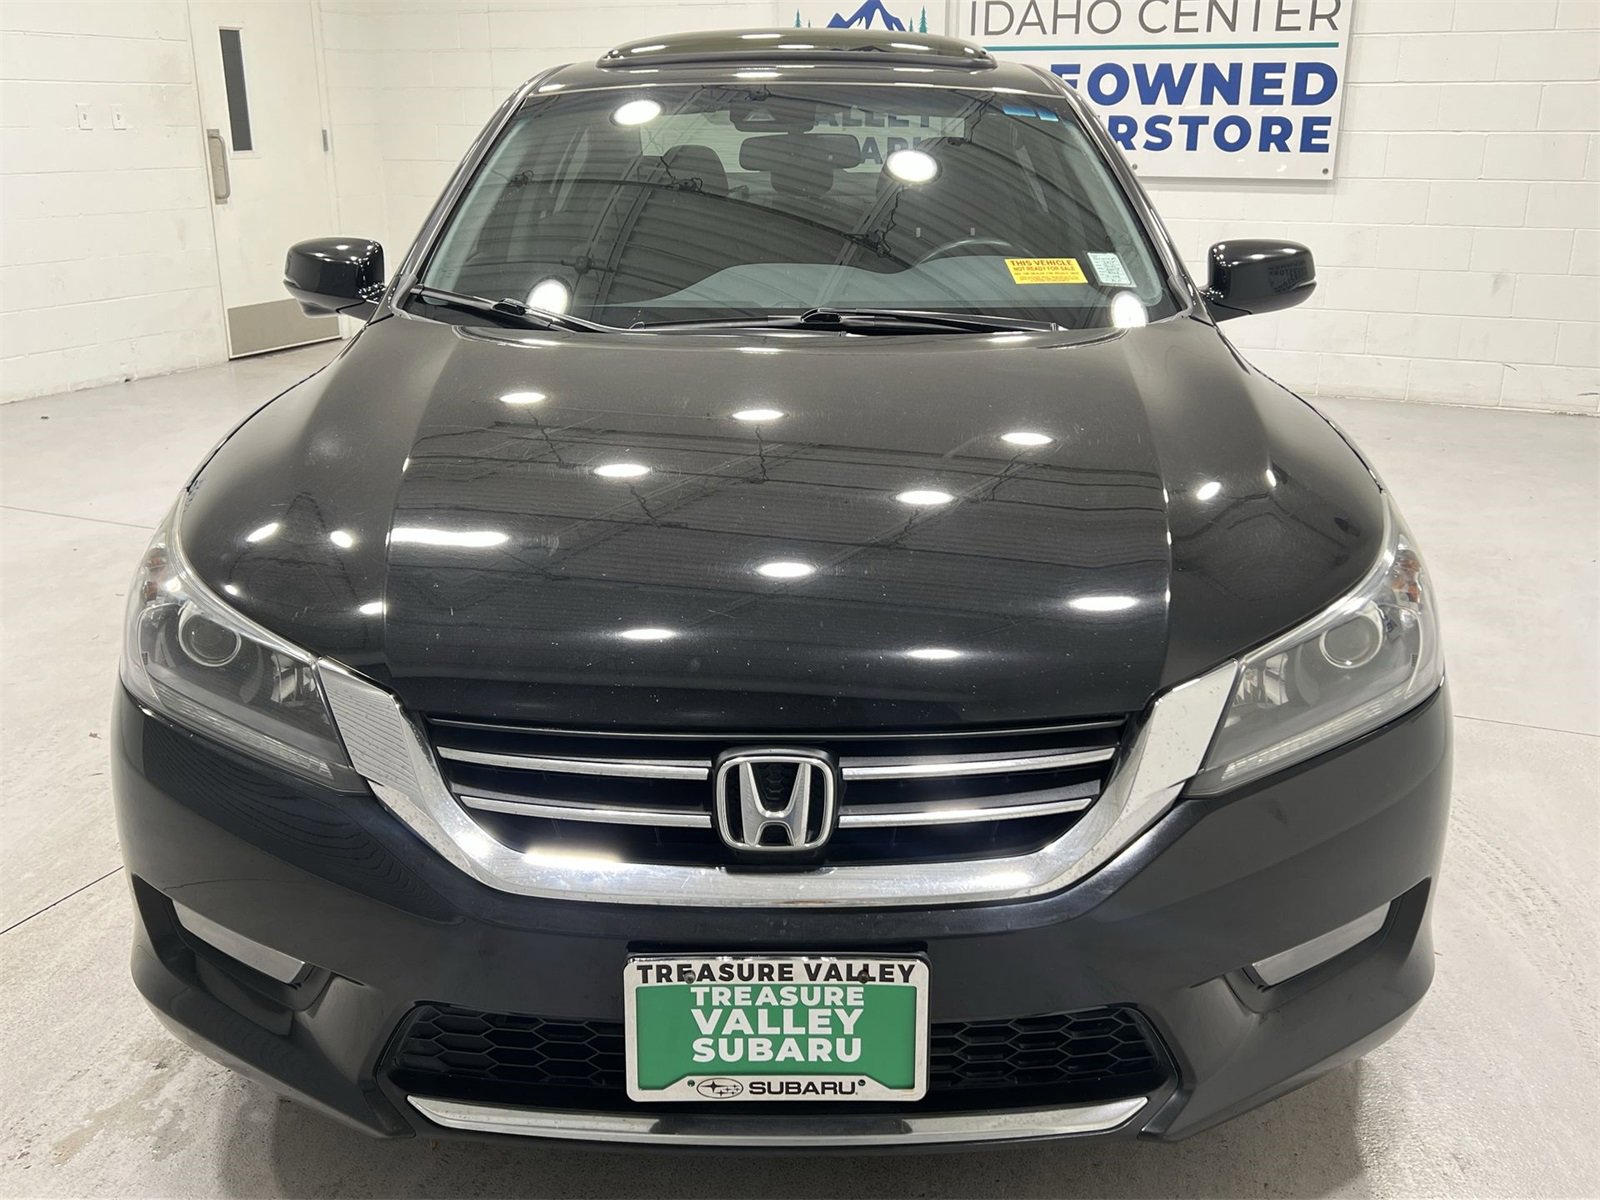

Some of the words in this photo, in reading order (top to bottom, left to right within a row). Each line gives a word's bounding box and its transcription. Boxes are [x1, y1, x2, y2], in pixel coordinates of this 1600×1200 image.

[970, 0, 1122, 36] IDAHO
[1138, 0, 1342, 34] CENTER
[637, 963, 794, 984] TREASURE
[805, 963, 916, 983] VALLEY
[690, 986, 865, 1007] TREASURE
[690, 1008, 864, 1036] VALLEY
[691, 1037, 862, 1063] SUBARU
[748, 1081, 857, 1095] SUBARU
